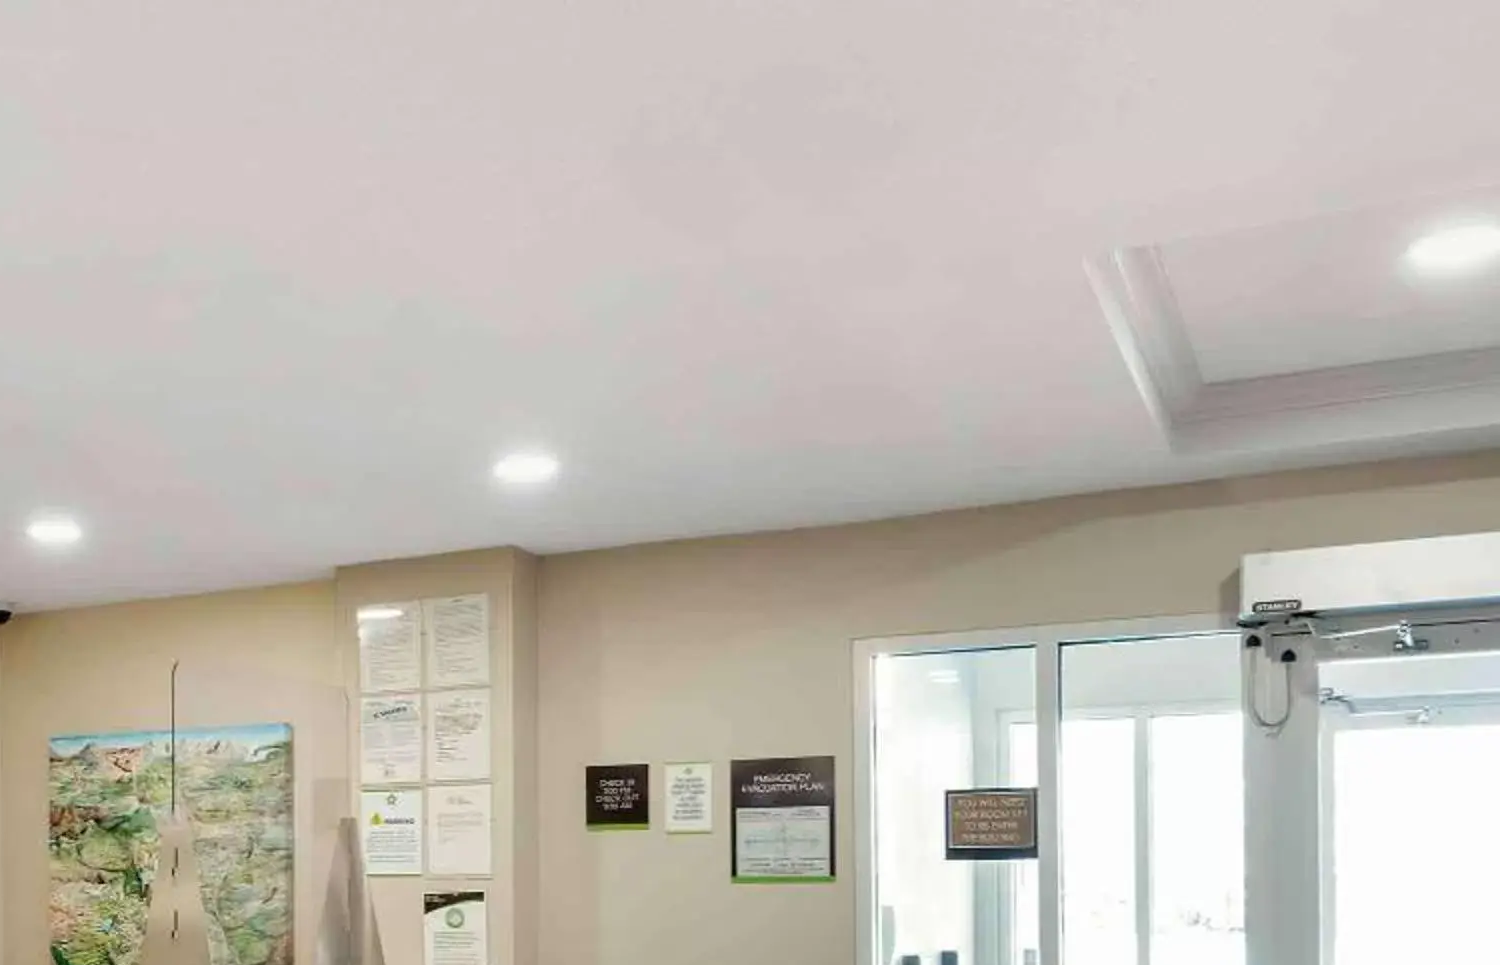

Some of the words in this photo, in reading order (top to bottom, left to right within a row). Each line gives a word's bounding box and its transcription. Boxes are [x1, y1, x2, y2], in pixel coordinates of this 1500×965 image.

[1255, 601, 1299, 611] STANLEY
[599, 779, 624, 787] CHECK
[753, 773, 811, 784] EMERGENCY
[741, 784, 798, 794] EVACUATION
[800, 782, 825, 792] PLAN
[595, 794, 620, 803] CHECK
